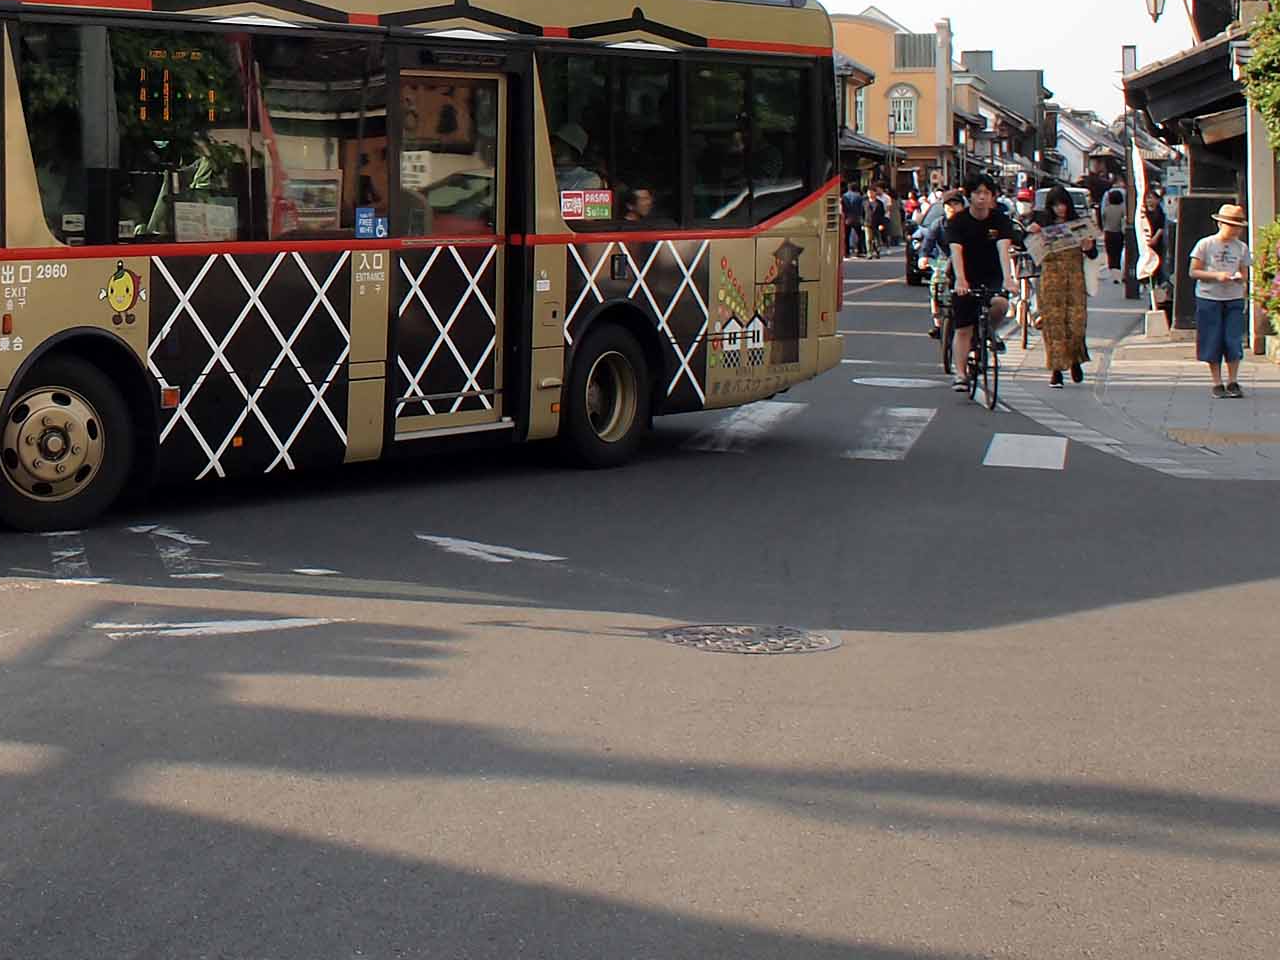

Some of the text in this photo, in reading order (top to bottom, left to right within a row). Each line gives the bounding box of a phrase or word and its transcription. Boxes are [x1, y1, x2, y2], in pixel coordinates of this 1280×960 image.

[584, 193, 610, 203] PASMO
[585, 207, 609, 217] Suica
[359, 253, 384, 270] 入口
[1, 263, 68, 284] 出口 2960
[355, 271, 385, 282] ENTRANCE
[4, 287, 27, 299] EXIT
